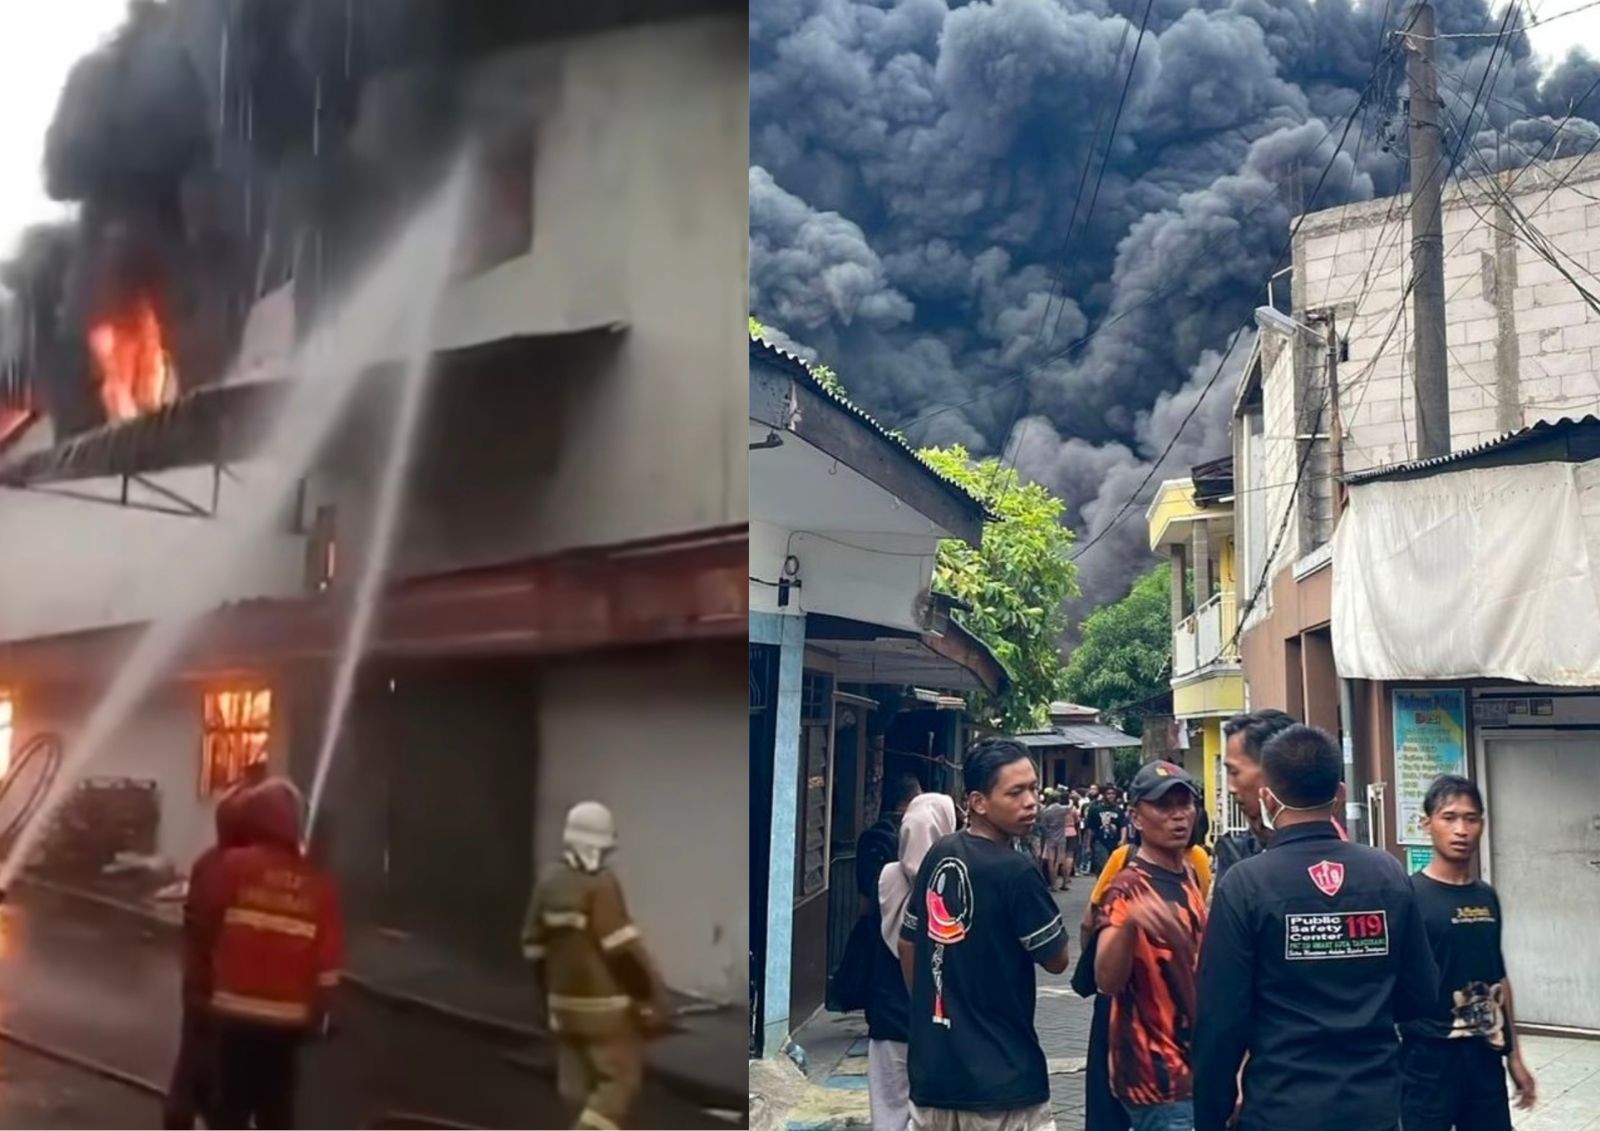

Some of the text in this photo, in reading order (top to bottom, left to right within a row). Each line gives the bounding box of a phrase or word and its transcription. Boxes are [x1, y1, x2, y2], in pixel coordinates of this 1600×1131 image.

[1315, 867, 1340, 886] 119
[1290, 917, 1341, 925] Public
[1290, 924, 1342, 933] Safety
[1346, 915, 1382, 938] 119
[1290, 932, 1344, 941] Center
